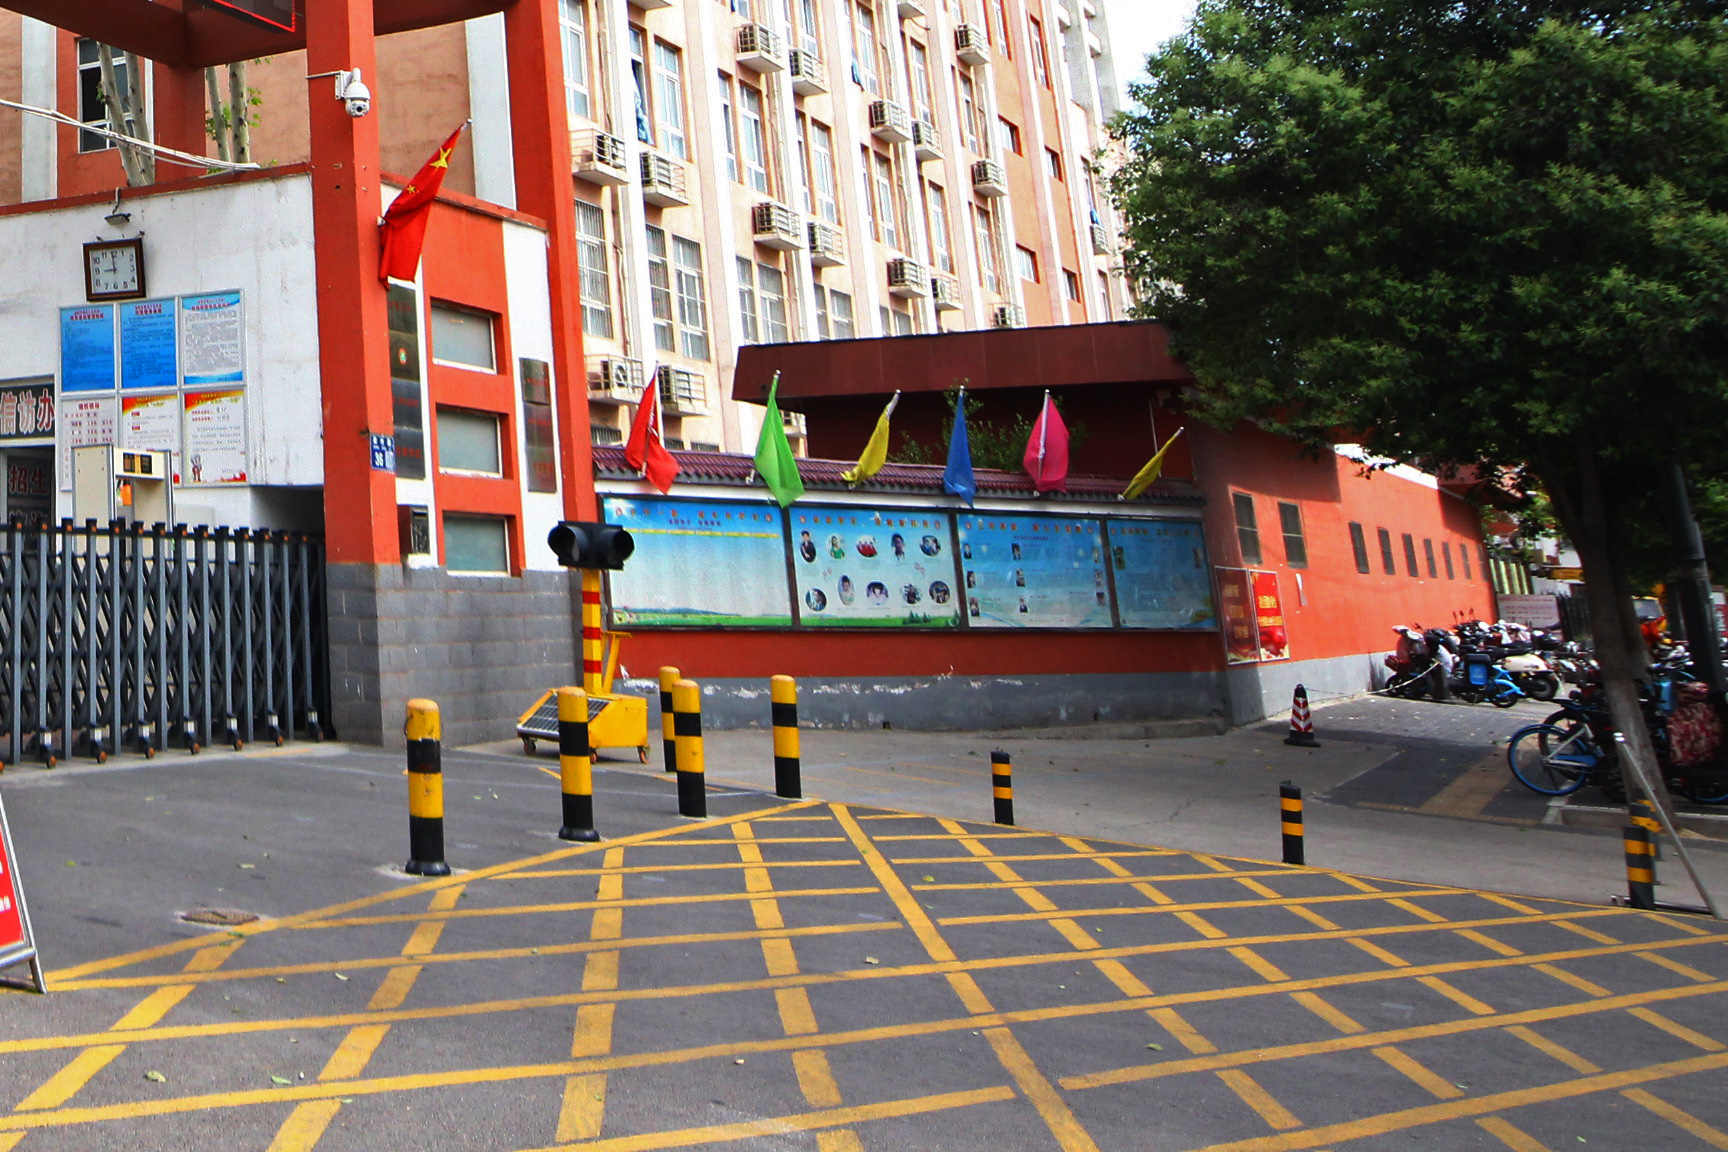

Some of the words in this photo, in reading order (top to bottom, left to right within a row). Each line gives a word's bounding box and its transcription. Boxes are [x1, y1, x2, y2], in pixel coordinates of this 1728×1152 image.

[0, 389, 55, 435] 信访办
[9, 464, 48, 494] 招生
